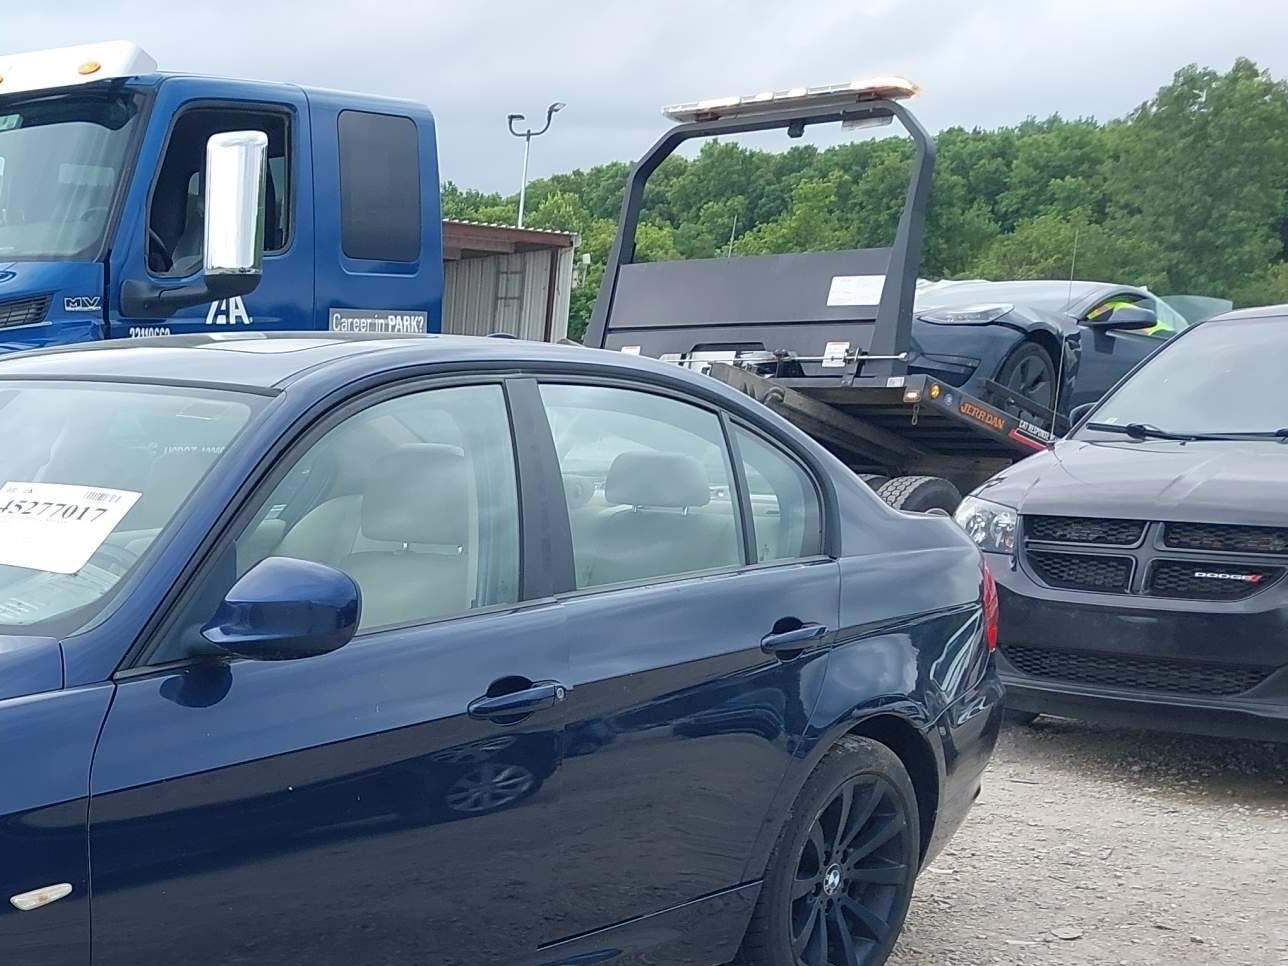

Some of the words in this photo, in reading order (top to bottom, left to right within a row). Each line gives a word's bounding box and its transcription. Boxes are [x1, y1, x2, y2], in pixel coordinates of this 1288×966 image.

[64, 296, 101, 311] MV
[332, 312, 373, 332] Career
[374, 314, 385, 333] in
[387, 314, 424, 333] PARK?
[1194, 572, 1251, 581] DODGE
